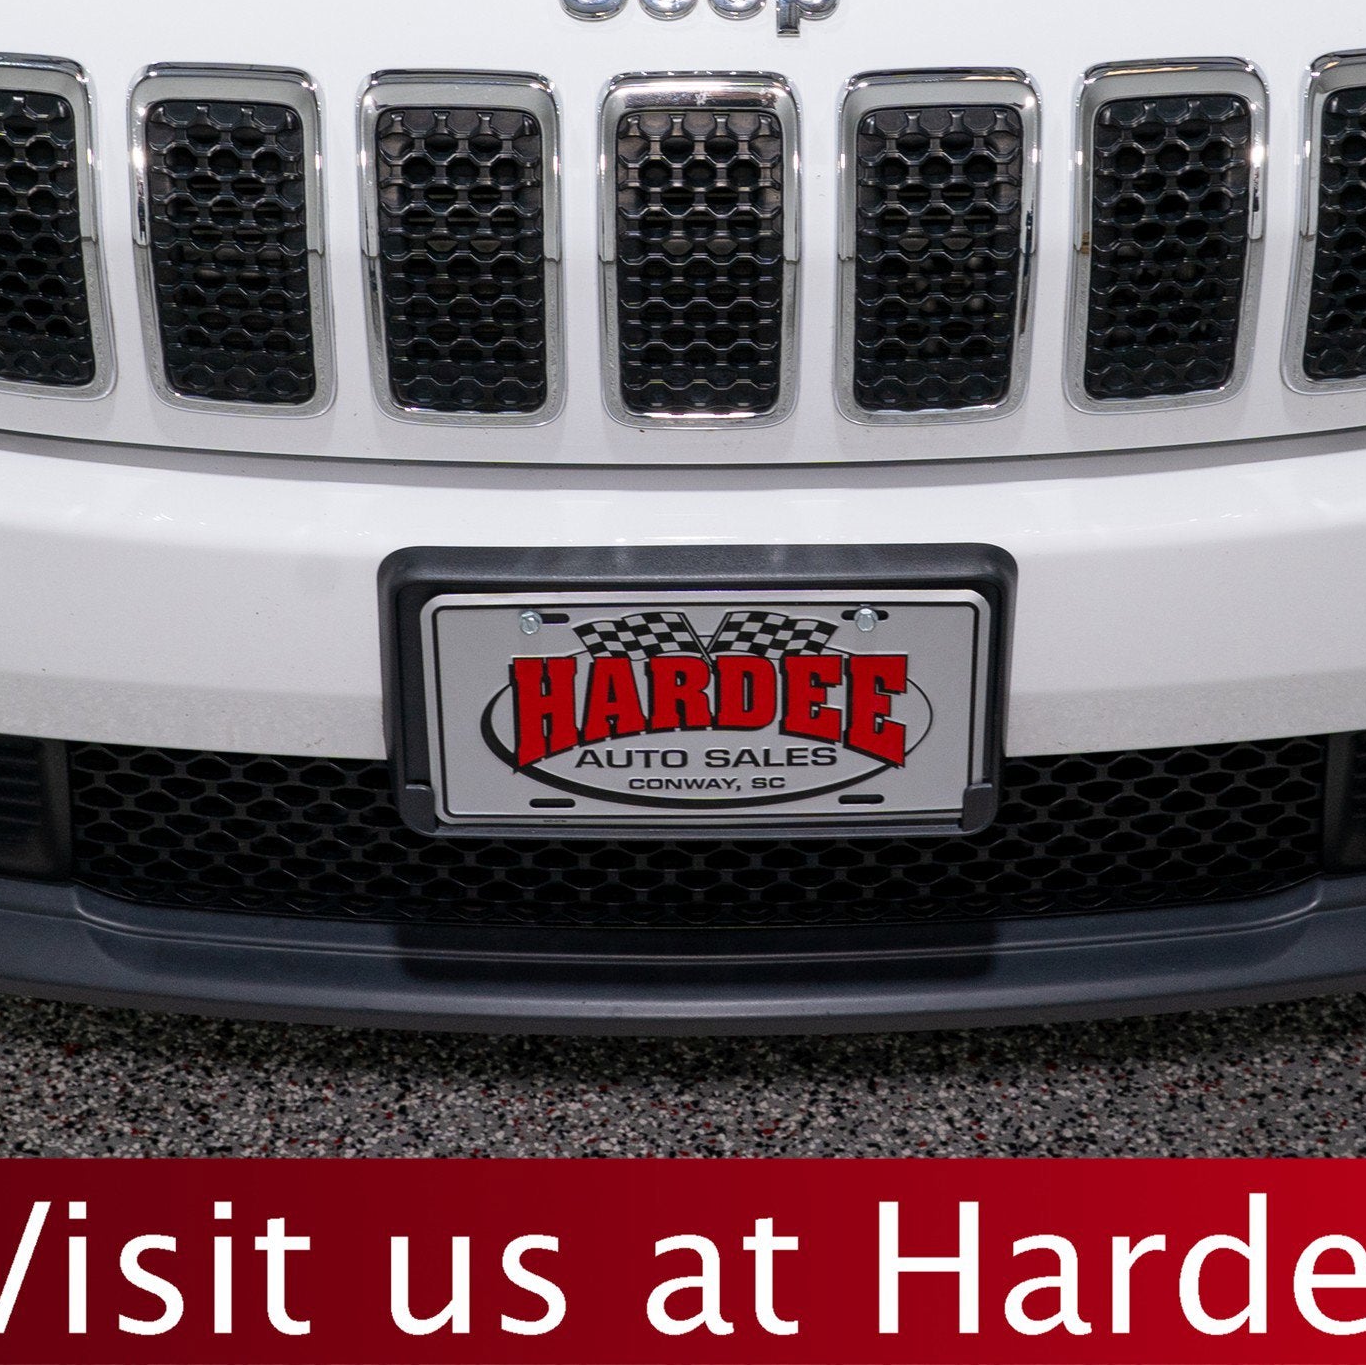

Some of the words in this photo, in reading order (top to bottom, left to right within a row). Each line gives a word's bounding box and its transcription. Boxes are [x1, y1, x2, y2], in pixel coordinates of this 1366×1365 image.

[508, 653, 908, 771] HARDEE
[575, 748, 689, 769] AUTO
[704, 746, 838, 768] SALES
[628, 777, 742, 792] CONWAY,
[751, 776, 786, 790] SC
